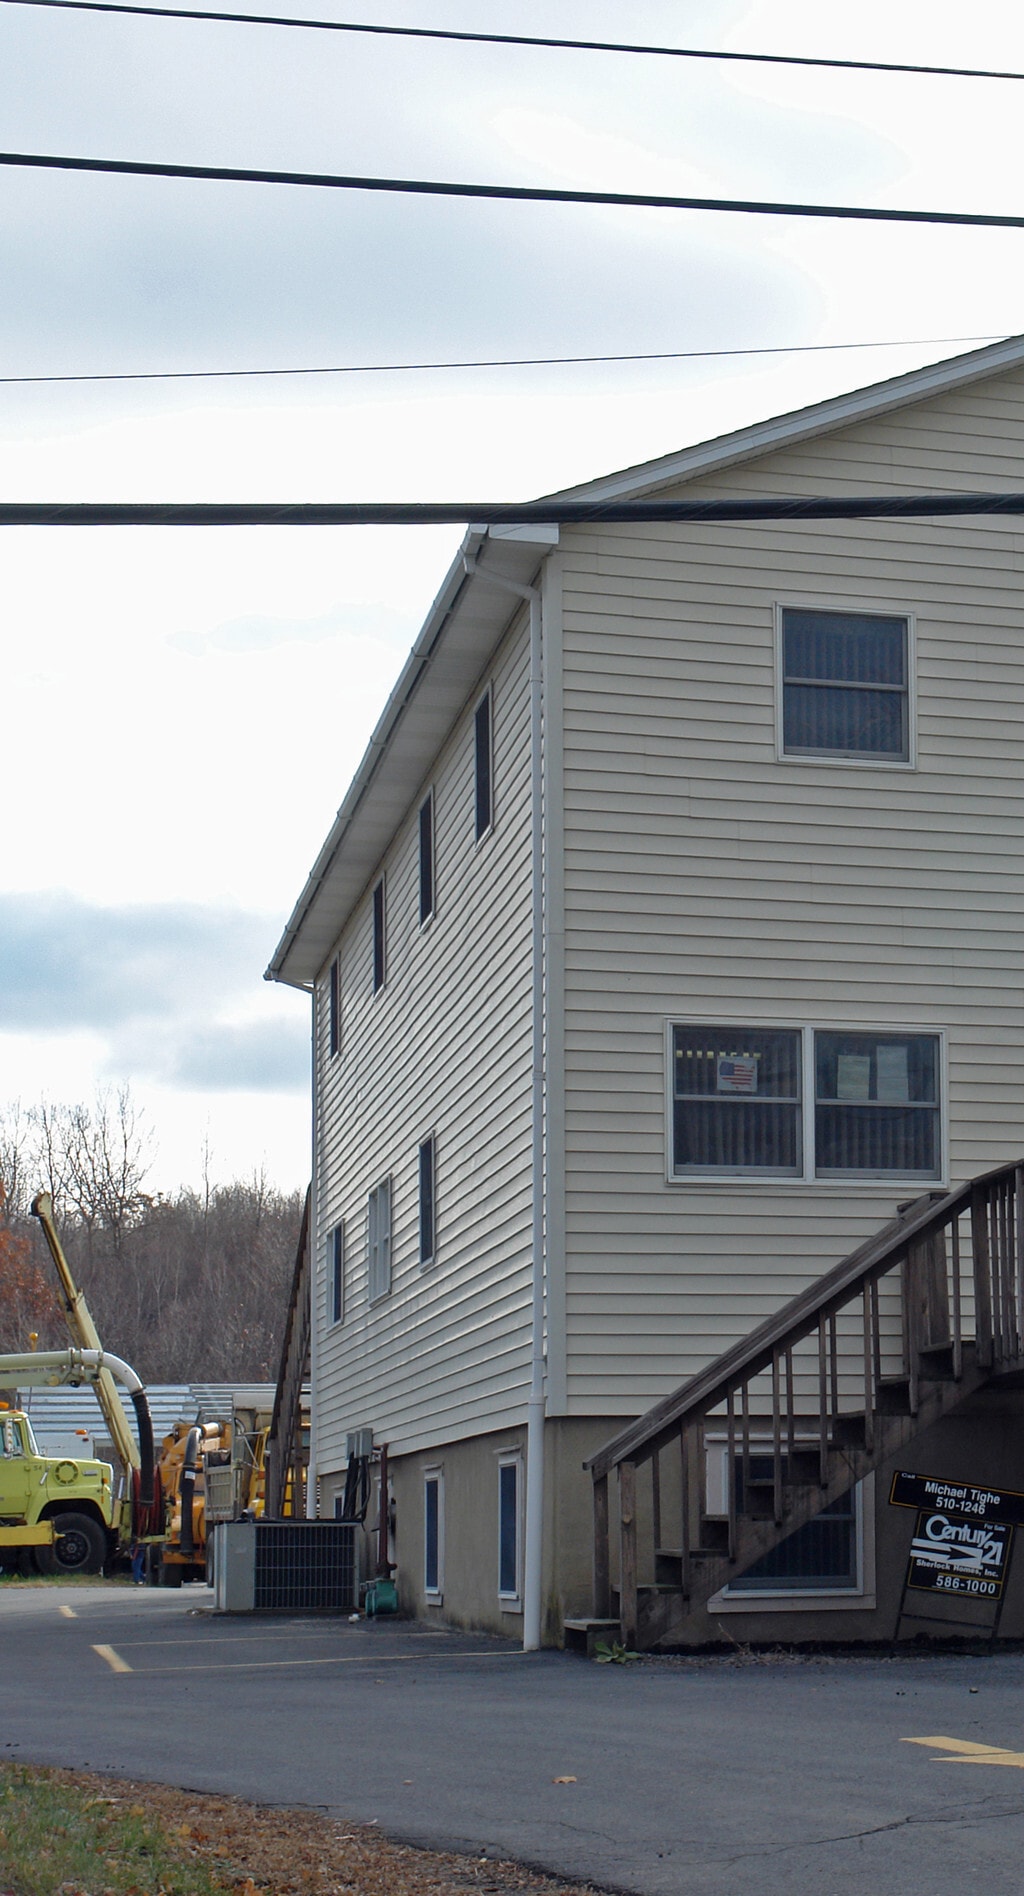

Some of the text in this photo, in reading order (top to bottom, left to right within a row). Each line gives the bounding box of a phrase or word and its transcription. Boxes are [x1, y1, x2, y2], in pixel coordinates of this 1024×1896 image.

[924, 1481, 1001, 1505] Michael Tighe
[935, 1496, 986, 1515] 510-1246
[925, 1514, 994, 1548] Century
[982, 1540, 1003, 1566] 21
[916, 1558, 950, 1571] Sherlock
[935, 1575, 996, 1594] 586-1000
